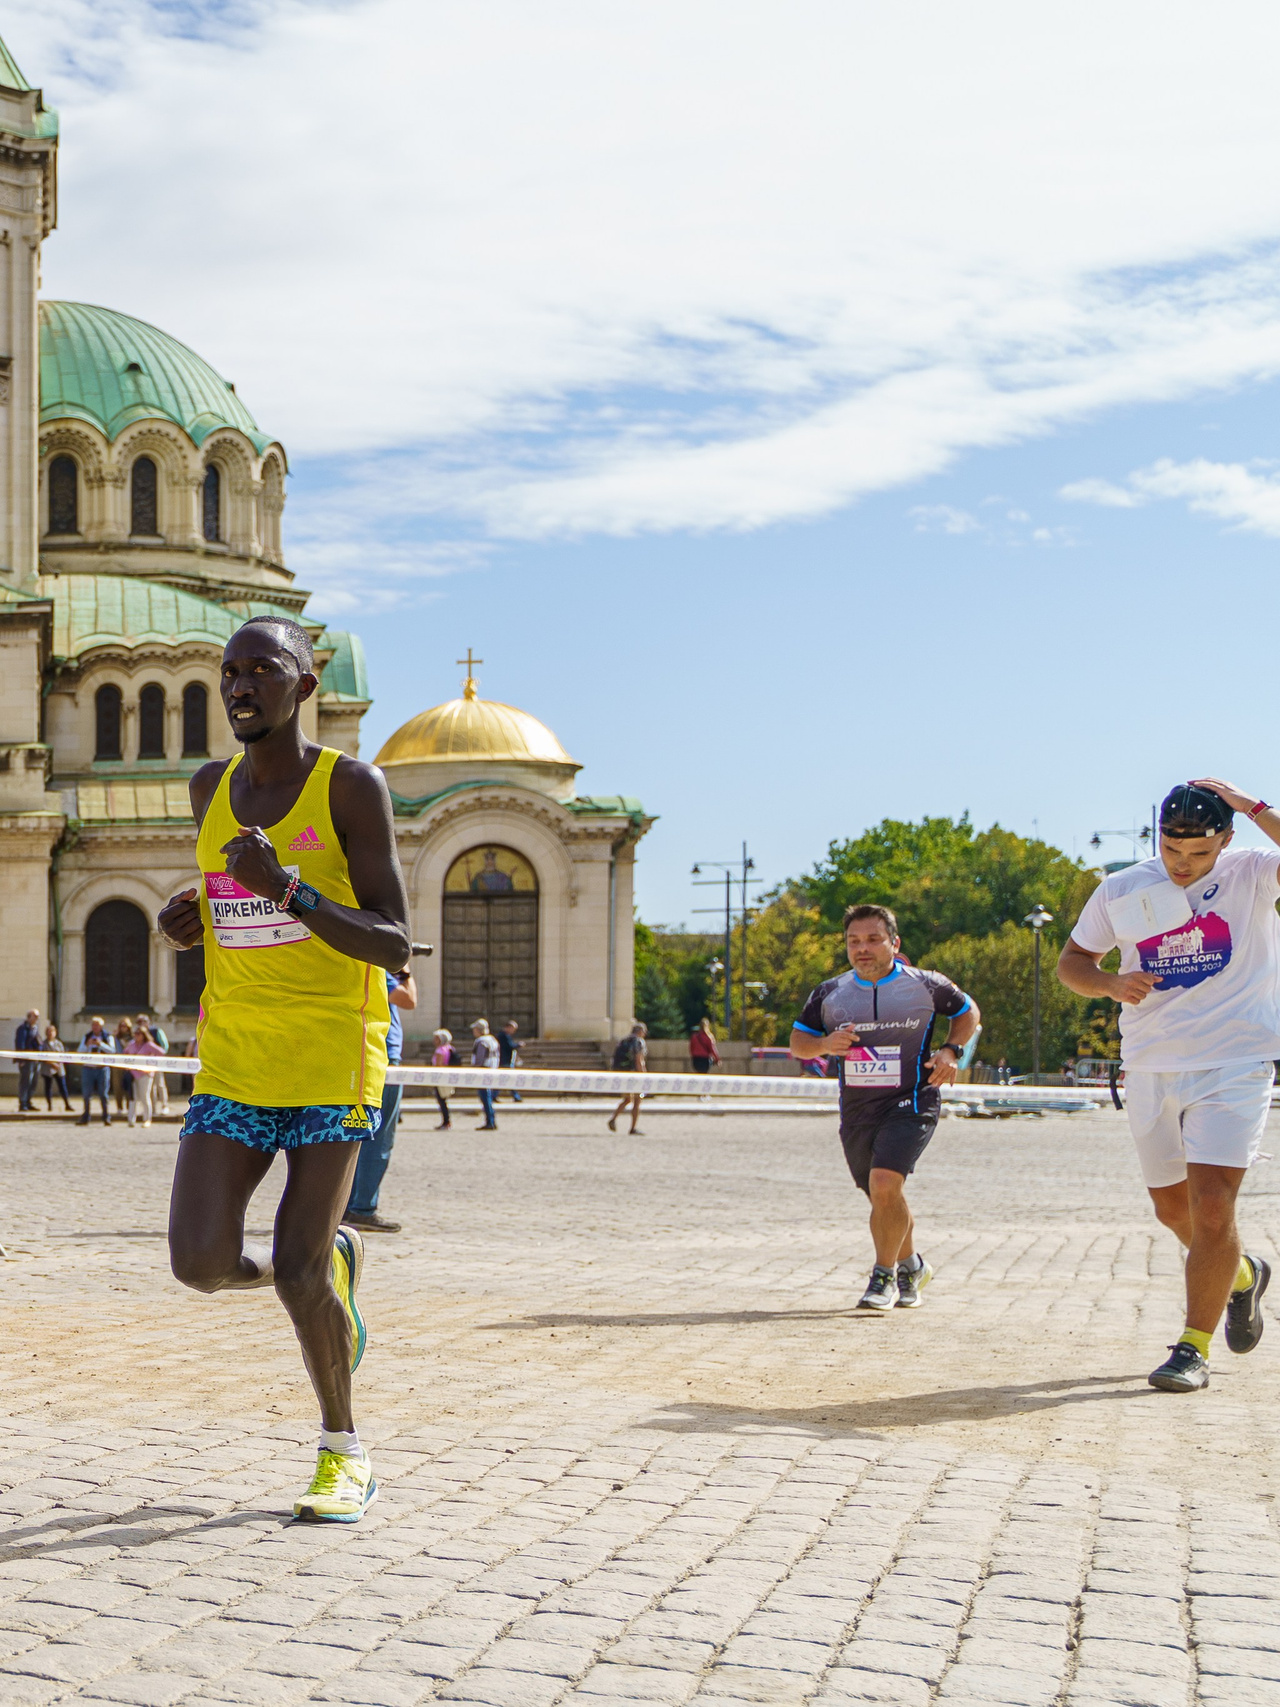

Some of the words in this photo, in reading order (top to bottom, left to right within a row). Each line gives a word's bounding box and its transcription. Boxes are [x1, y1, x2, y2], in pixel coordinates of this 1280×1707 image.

[288, 841, 326, 851] adidas
[1147, 959, 1170, 968] WIZZ
[1173, 957, 1190, 966] AIR
[1192, 953, 1222, 964] SOFIA
[853, 1062, 887, 1073] 1374
[341, 1119, 373, 1129] adidas
